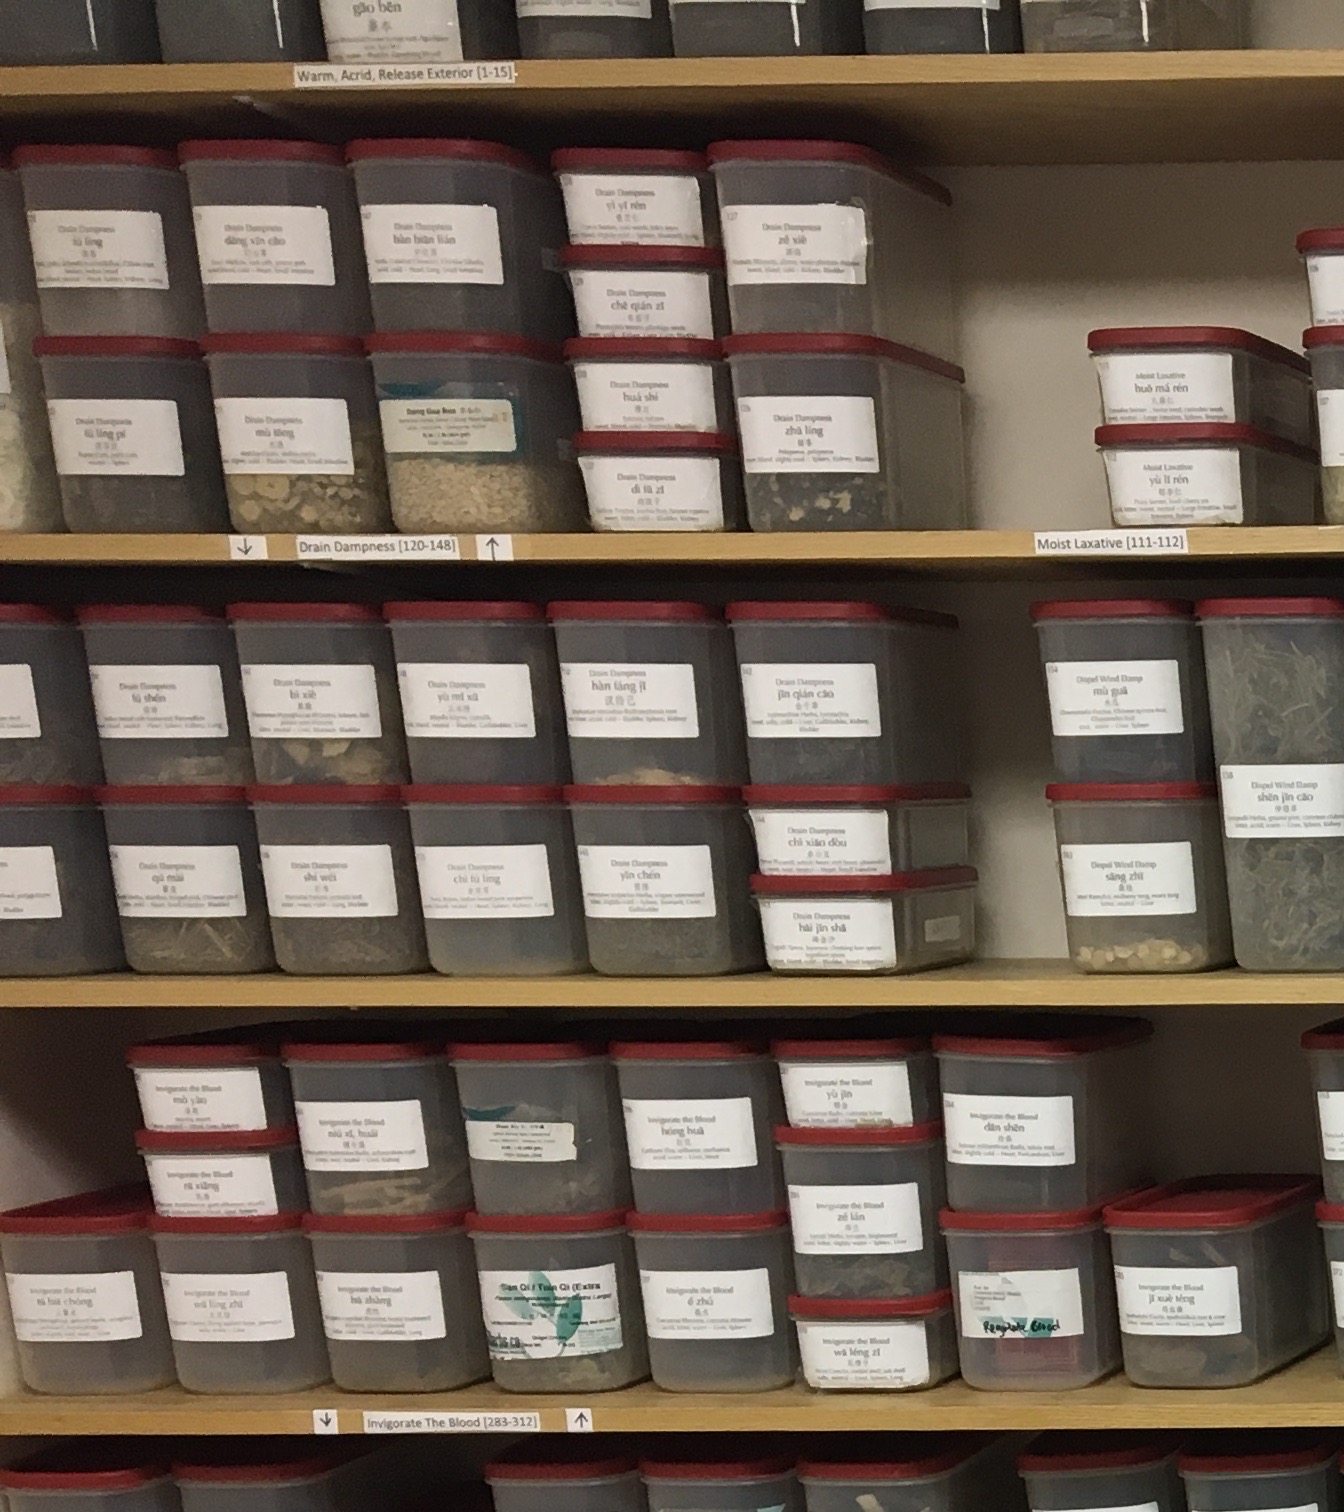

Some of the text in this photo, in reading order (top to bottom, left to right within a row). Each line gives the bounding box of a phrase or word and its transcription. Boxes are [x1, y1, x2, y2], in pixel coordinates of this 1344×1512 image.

[297, 65, 513, 83] Warm, Acrid, Release Exterior [1-15]
[300, 539, 456, 554] Drain Dampness [120-148]
[1037, 535, 1184, 550] Moist Laxative [111-112]
[367, 1416, 537, 1431] Invigorate The Blood [283-312]
